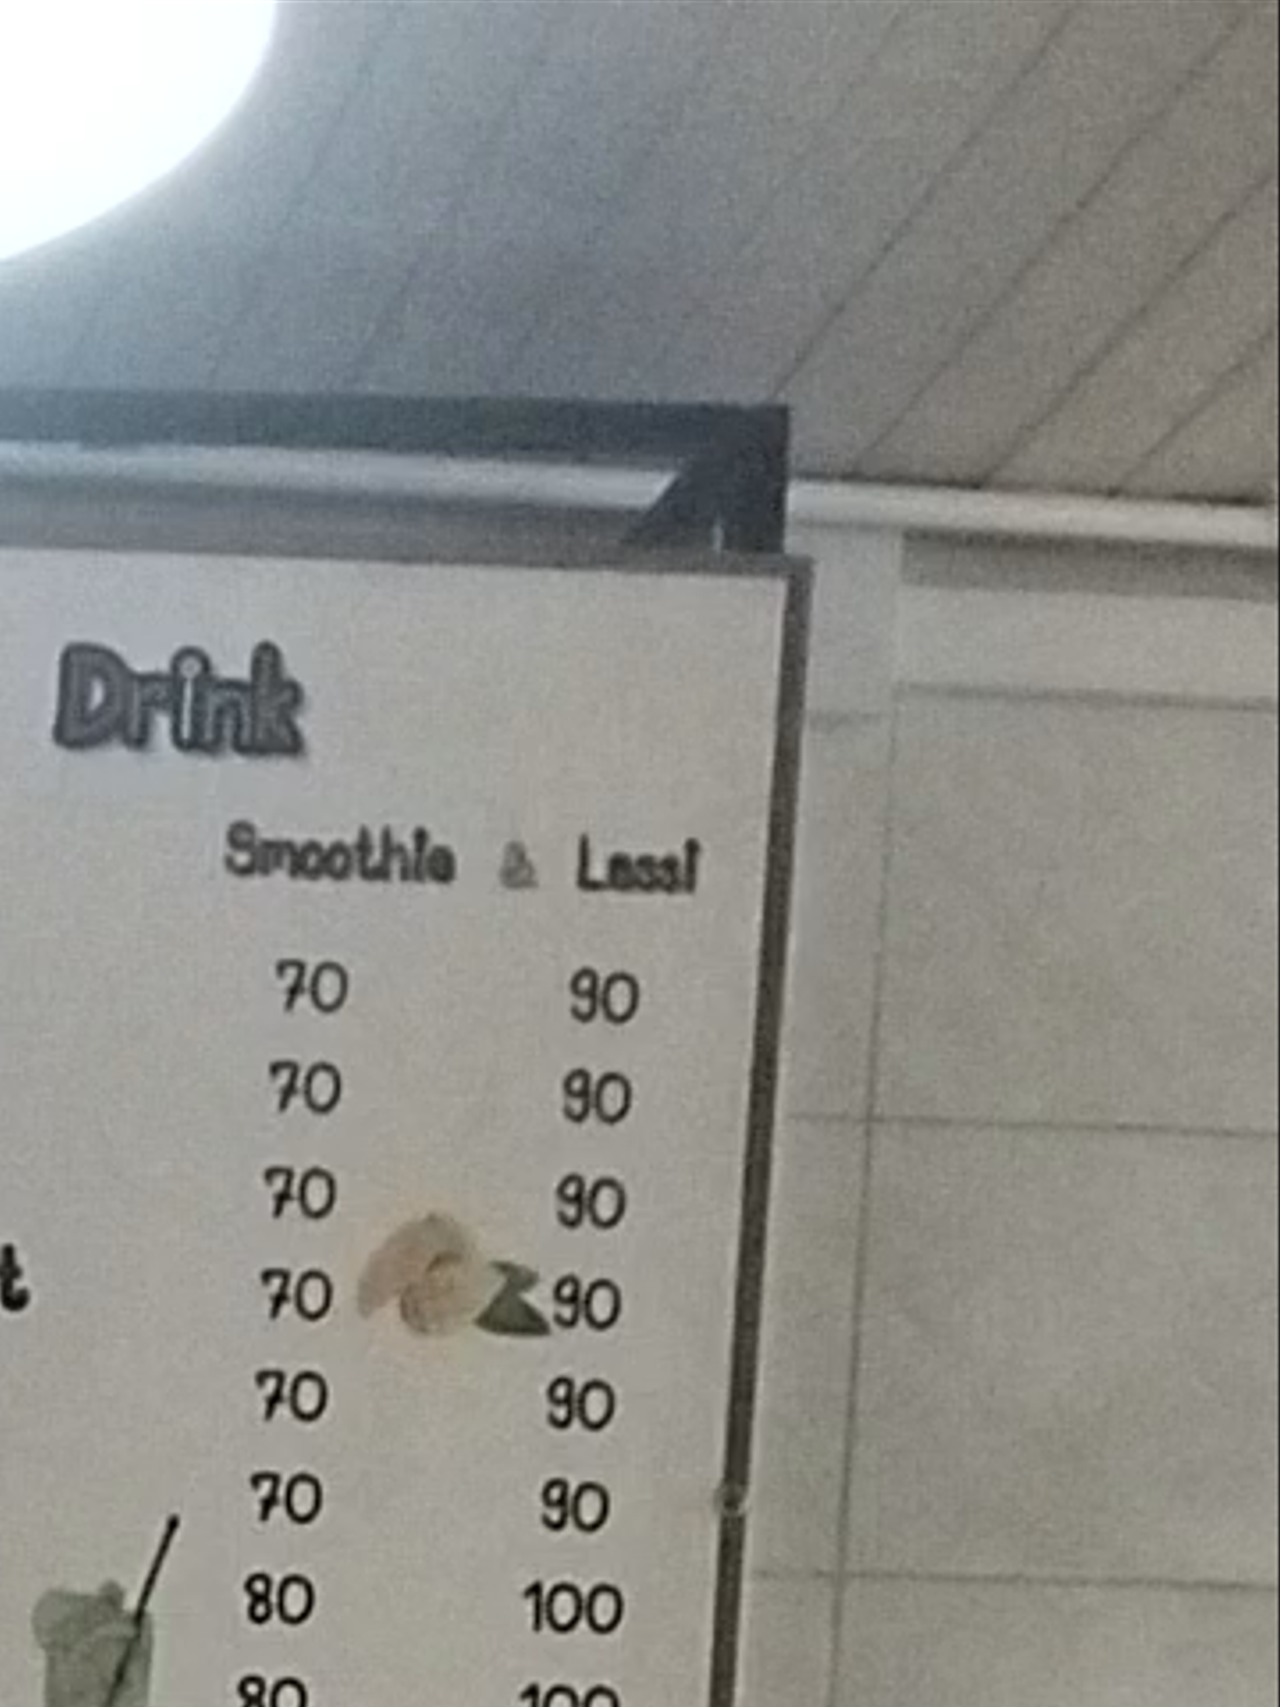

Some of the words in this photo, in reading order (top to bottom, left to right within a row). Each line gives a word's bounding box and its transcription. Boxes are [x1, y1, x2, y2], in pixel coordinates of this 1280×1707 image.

[52, 641, 308, 761] Drink
[224, 820, 456, 885] Smoothie
[500, 841, 538, 890] &
[275, 959, 349, 1014] 70
[569, 966, 640, 1025] 90
[269, 1059, 342, 1115] 70
[562, 1068, 632, 1126] 90
[263, 1165, 337, 1221] 70
[555, 1173, 627, 1230] 90
[260, 1268, 334, 1322] 70
[552, 1273, 622, 1332] 90
[254, 1369, 329, 1423] 70
[546, 1375, 616, 1432] 90
[249, 1471, 323, 1525] 70
[541, 1477, 610, 1534] 90
[243, 1572, 316, 1626] 80
[522, 1580, 624, 1635] 100
